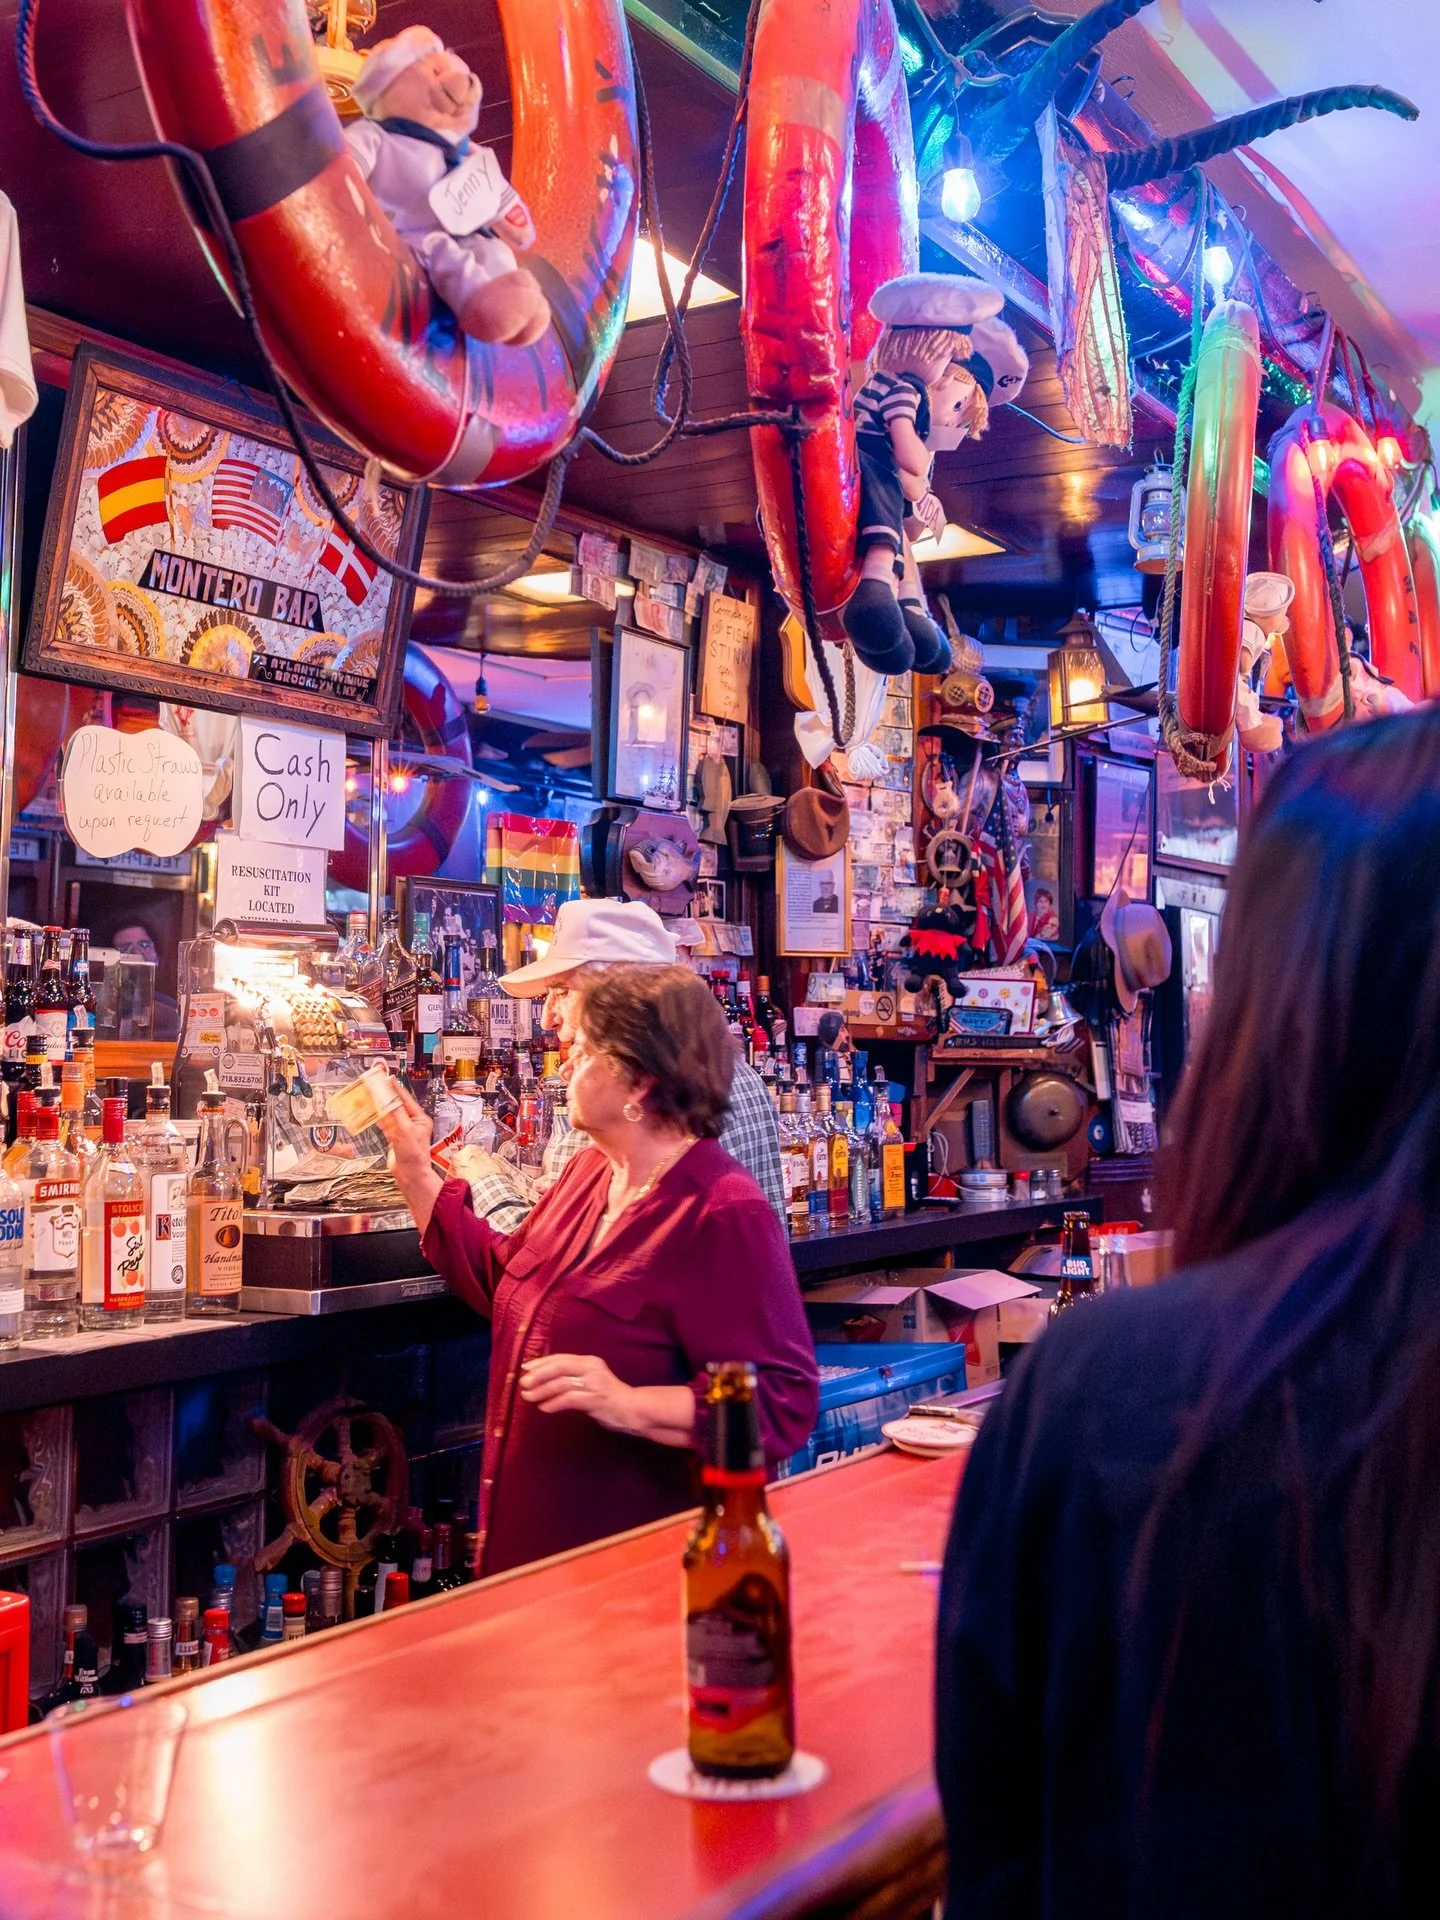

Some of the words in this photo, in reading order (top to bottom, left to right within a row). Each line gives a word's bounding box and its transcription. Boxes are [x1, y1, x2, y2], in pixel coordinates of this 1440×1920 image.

[444, 155, 493, 216] Jenny
[149, 551, 263, 615] MONTERO
[271, 586, 319, 629] BAR
[270, 658, 328, 680] ATLANTIC
[274, 671, 335, 694] BROOKLYN
[79, 732, 136, 776] Plastic
[140, 739, 200, 777] Straws
[255, 733, 331, 784] Cash
[94, 778, 172, 804] available
[256, 781, 327, 839] Only
[79, 815, 117, 840] upon
[127, 805, 189, 842] request
[231, 864, 312, 883] RESUSCITATION
[263, 884, 281, 897] KIT
[248, 899, 295, 915] LOCATED
[491, 1003, 509, 1019] KNOB
[1062, 1266, 1091, 1276] LIGHT
[1066, 1259, 1087, 1269] BUD
